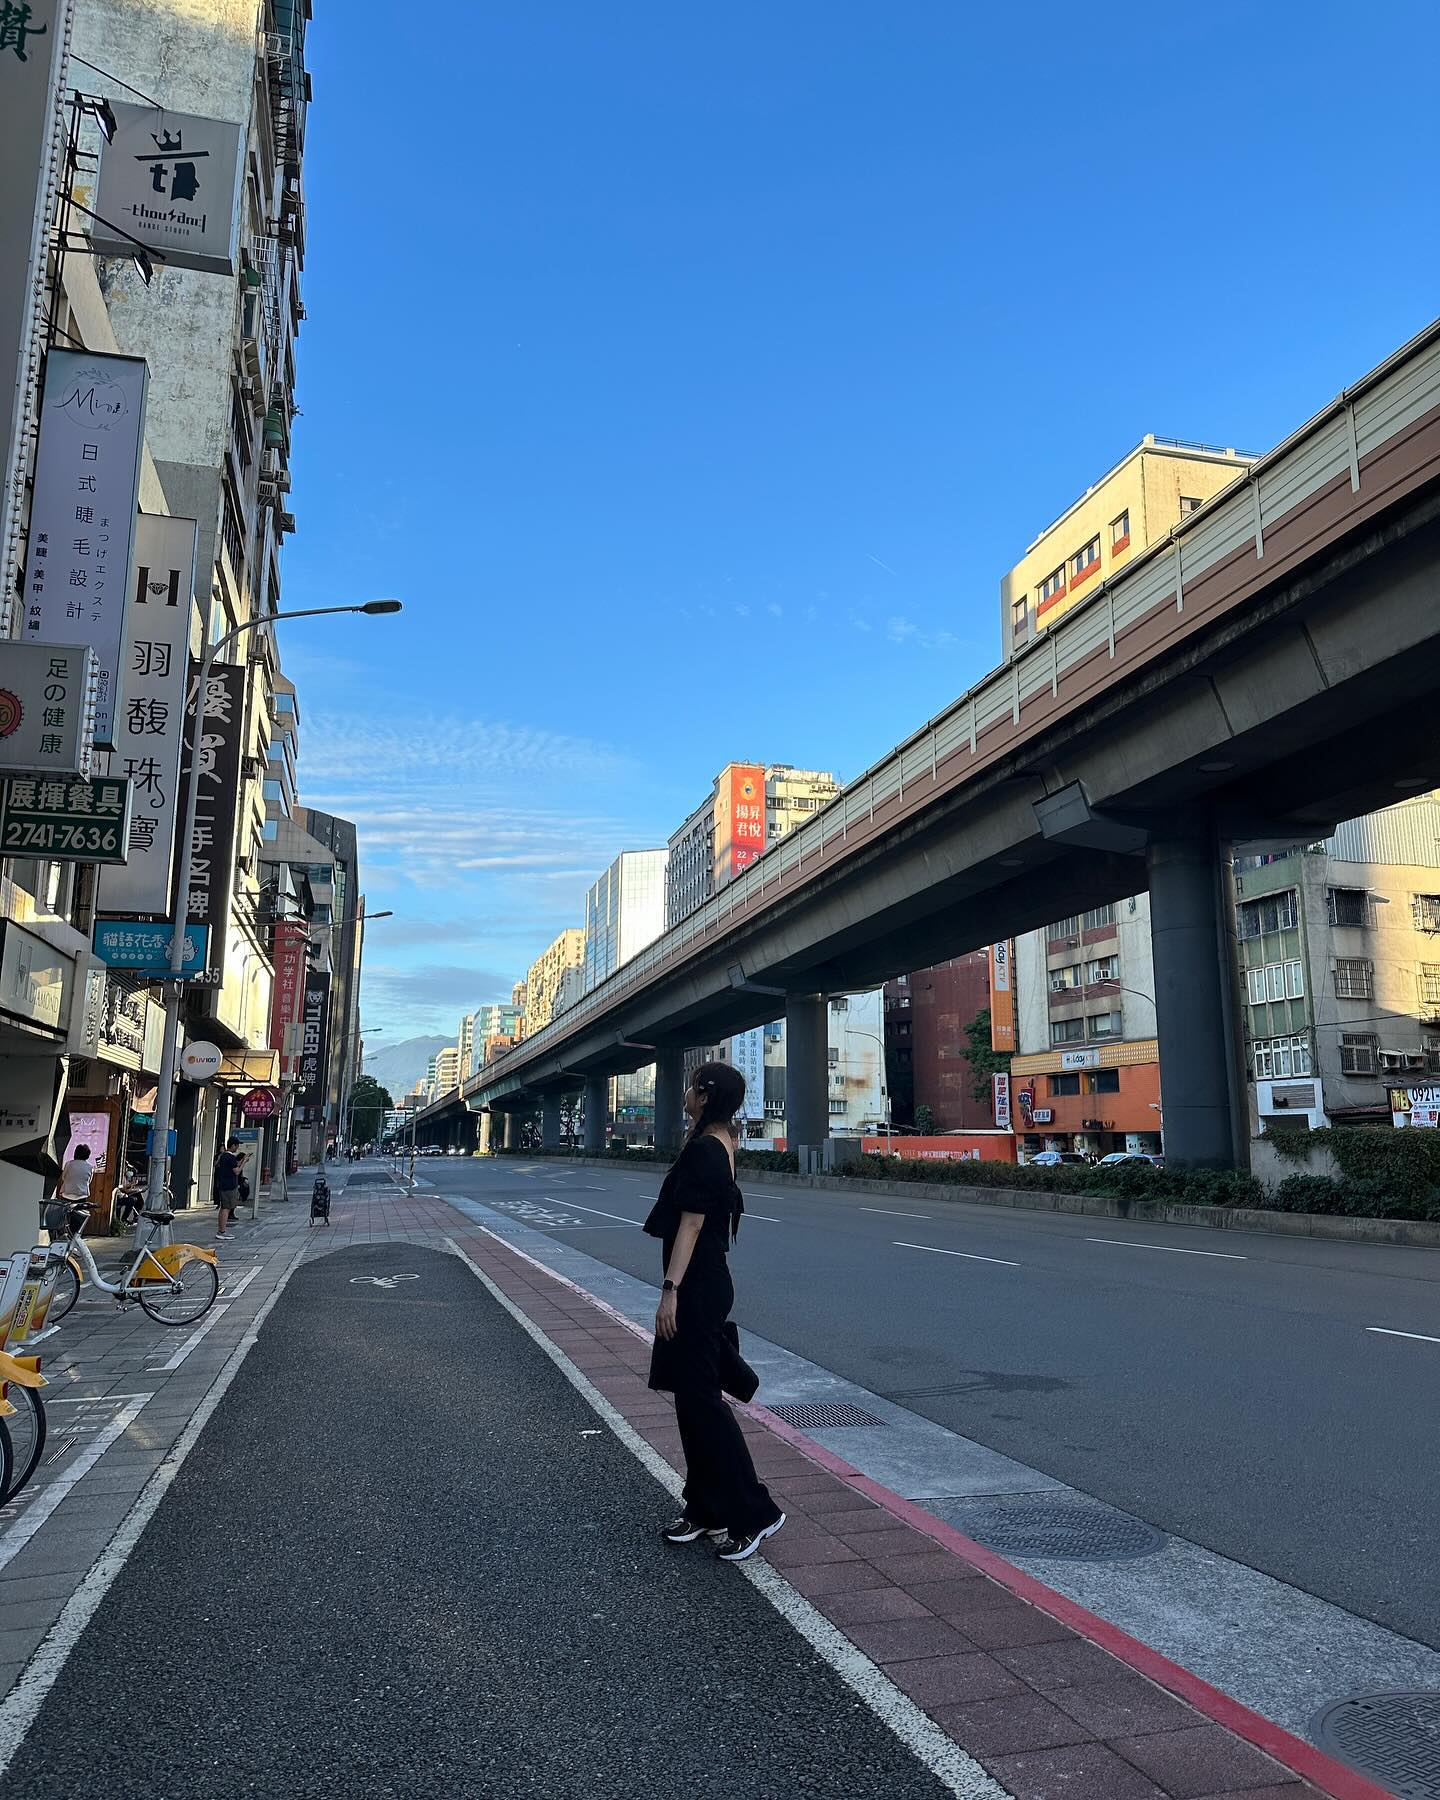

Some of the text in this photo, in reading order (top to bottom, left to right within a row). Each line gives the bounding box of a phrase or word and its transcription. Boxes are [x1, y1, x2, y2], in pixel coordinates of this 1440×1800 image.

[66, 443, 98, 620] 日式睫毛設計
[90, 517, 110, 622] まつげエクステ
[39, 658, 69, 754] 足の健康
[8, 780, 121, 814] 展揮餐具
[6, 822, 117, 851] 2741-7636
[103, 931, 165, 948] 貓語花香
[303, 1005, 322, 1055] TIGER
